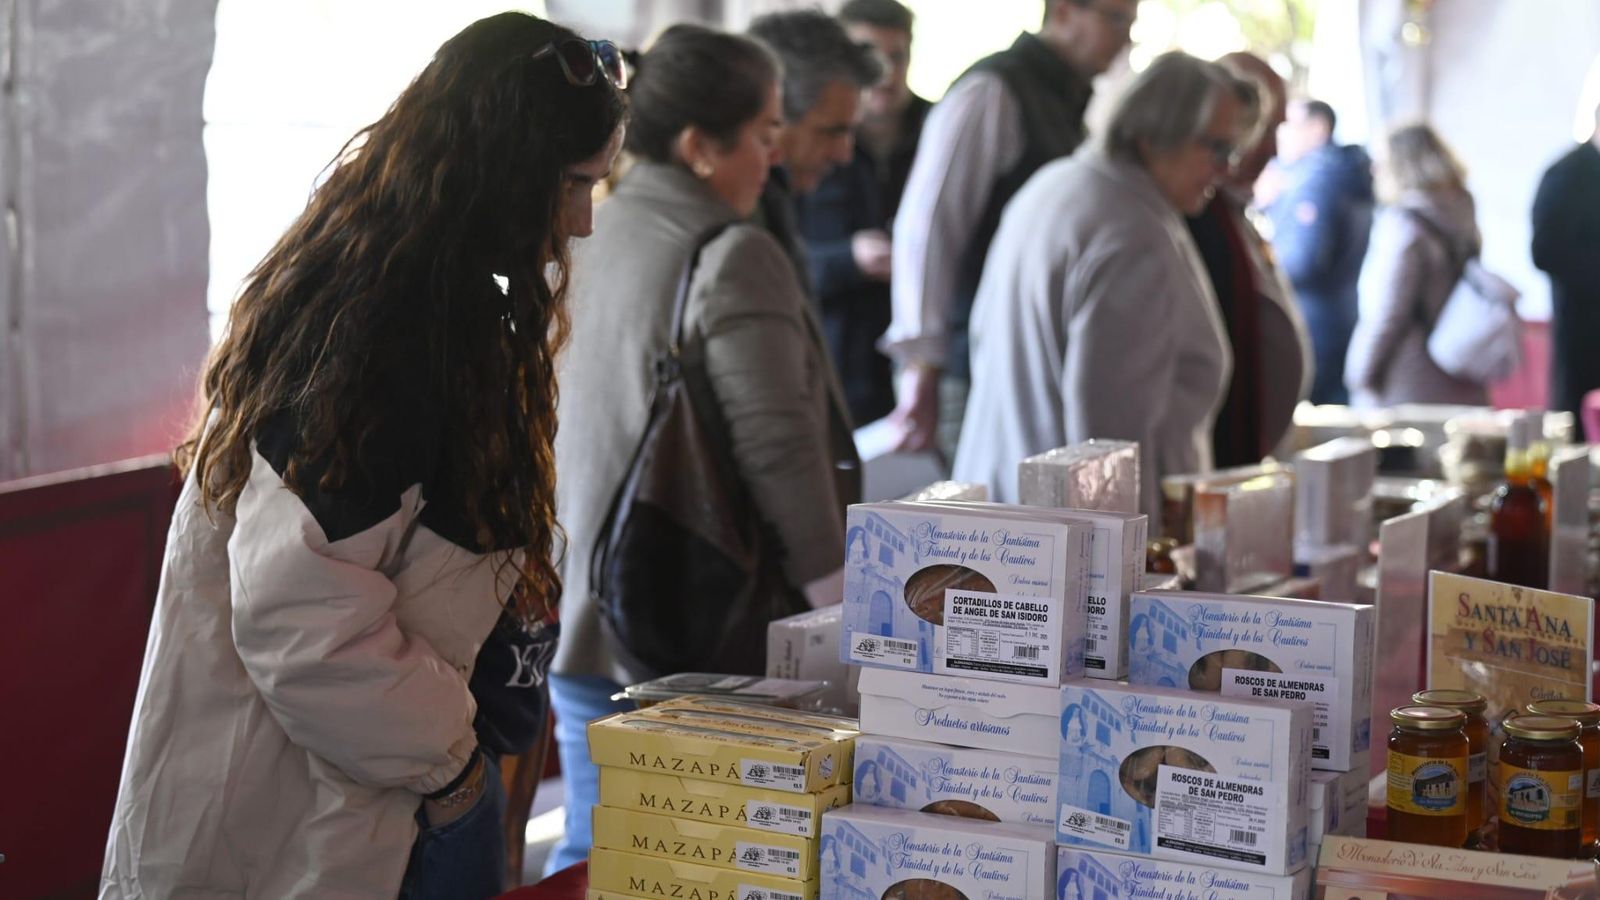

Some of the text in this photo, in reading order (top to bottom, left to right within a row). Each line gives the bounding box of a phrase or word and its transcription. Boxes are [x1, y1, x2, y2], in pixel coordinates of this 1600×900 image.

[916, 521, 1040, 549] Monasterio de la Santísima
[917, 541, 1036, 567] Trinidad y de los Cautivos
[953, 596, 1048, 613] CORTADILLOS DE CABELLO
[1088, 596, 1106, 605] ELLO
[952, 606, 1048, 623] DE ANGEL DE SAN ISIDORO
[1188, 604, 1312, 629] Monasterio de la Santísima
[1457, 592, 1572, 638] SANTA ANA
[1190, 623, 1308, 647] Trinidad y de los Cautivos
[1464, 626, 1571, 668] Y SAN JOSÉ
[1235, 676, 1324, 692] ROSCOS DE ALMENDRAS
[1252, 687, 1305, 700] DE SAN PEDRO
[915, 708, 1010, 736] Productos artesanos
[1121, 695, 1249, 724] Monasterio de la Santísima
[1126, 715, 1245, 743] Trinidad y de los Cautivos
[629, 752, 741, 779] MAZAPÁ
[927, 757, 1051, 787] Monasterio de la Santísima
[931, 776, 1048, 804] Trinidad y de los Cautivos
[1172, 773, 1263, 796] ROSCOS DE ALMENDRAS
[1189, 786, 1244, 803] DE SAN PEDRO
[639, 793, 747, 822] MAZAPÁ
[632, 835, 736, 863] MAZAPÁ
[888, 832, 1013, 864] Monasterio de la Santísima
[891, 852, 1009, 882] Trinidad y de los Cautivos
[1119, 861, 1249, 891] Monasterio de la Santísima
[629, 877, 735, 900] MAZAPÁ
[1122, 880, 1165, 900] Trinidad
[1176, 888, 1187, 900] de
